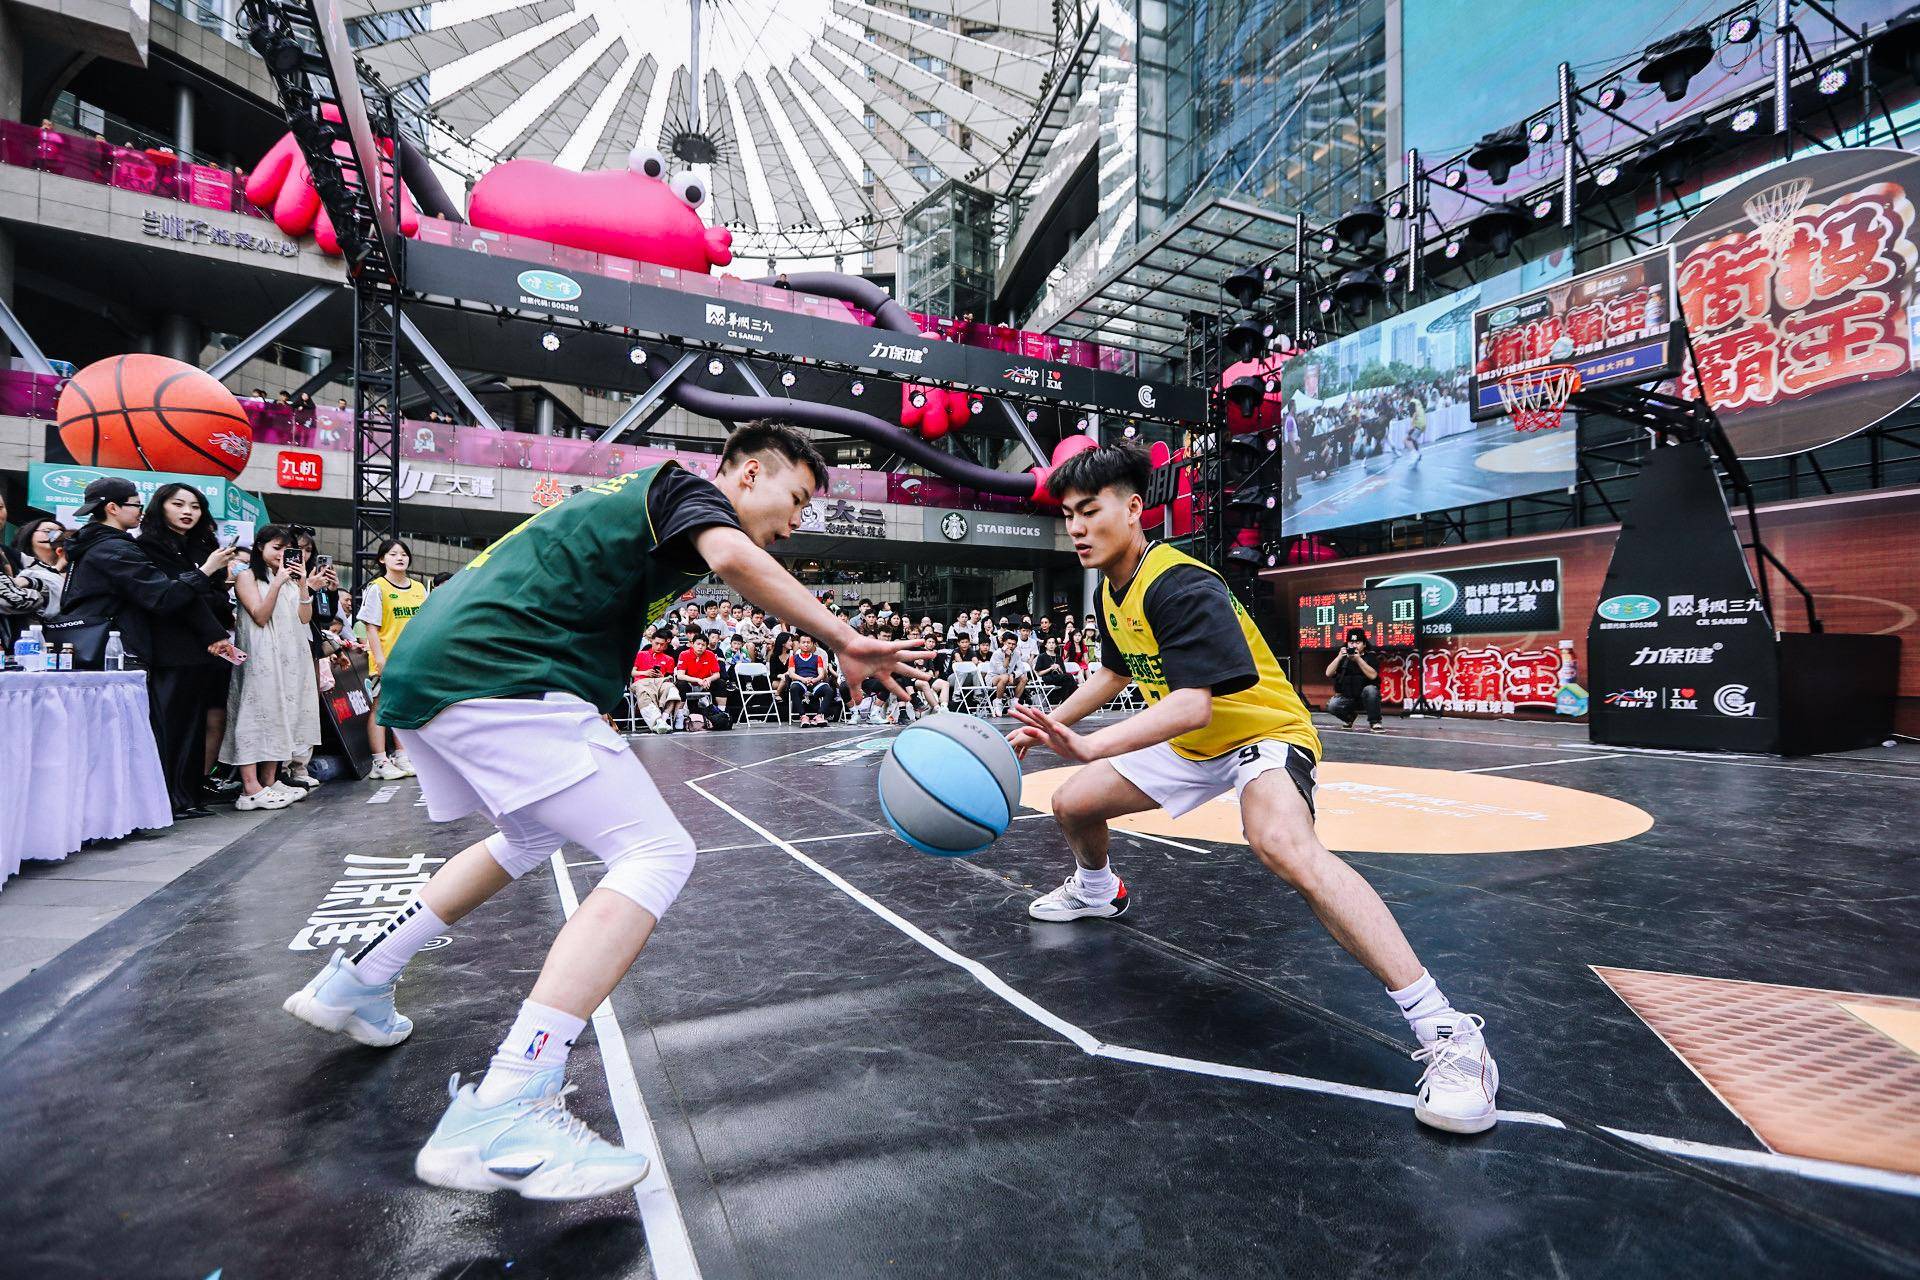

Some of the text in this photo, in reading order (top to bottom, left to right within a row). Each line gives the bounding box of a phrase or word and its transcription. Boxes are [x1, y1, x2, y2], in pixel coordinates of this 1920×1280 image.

[869, 342, 924, 365] 力保健
[1046, 379, 1063, 391] KM
[282, 459, 317, 476] 九机
[976, 523, 1041, 537] STARBUCKS
[1464, 579, 1555, 598] 陪伴您和家人的
[1465, 593, 1538, 615] 健康之家
[1629, 645, 1716, 666] 力保健
[1669, 699, 1698, 710] KM
